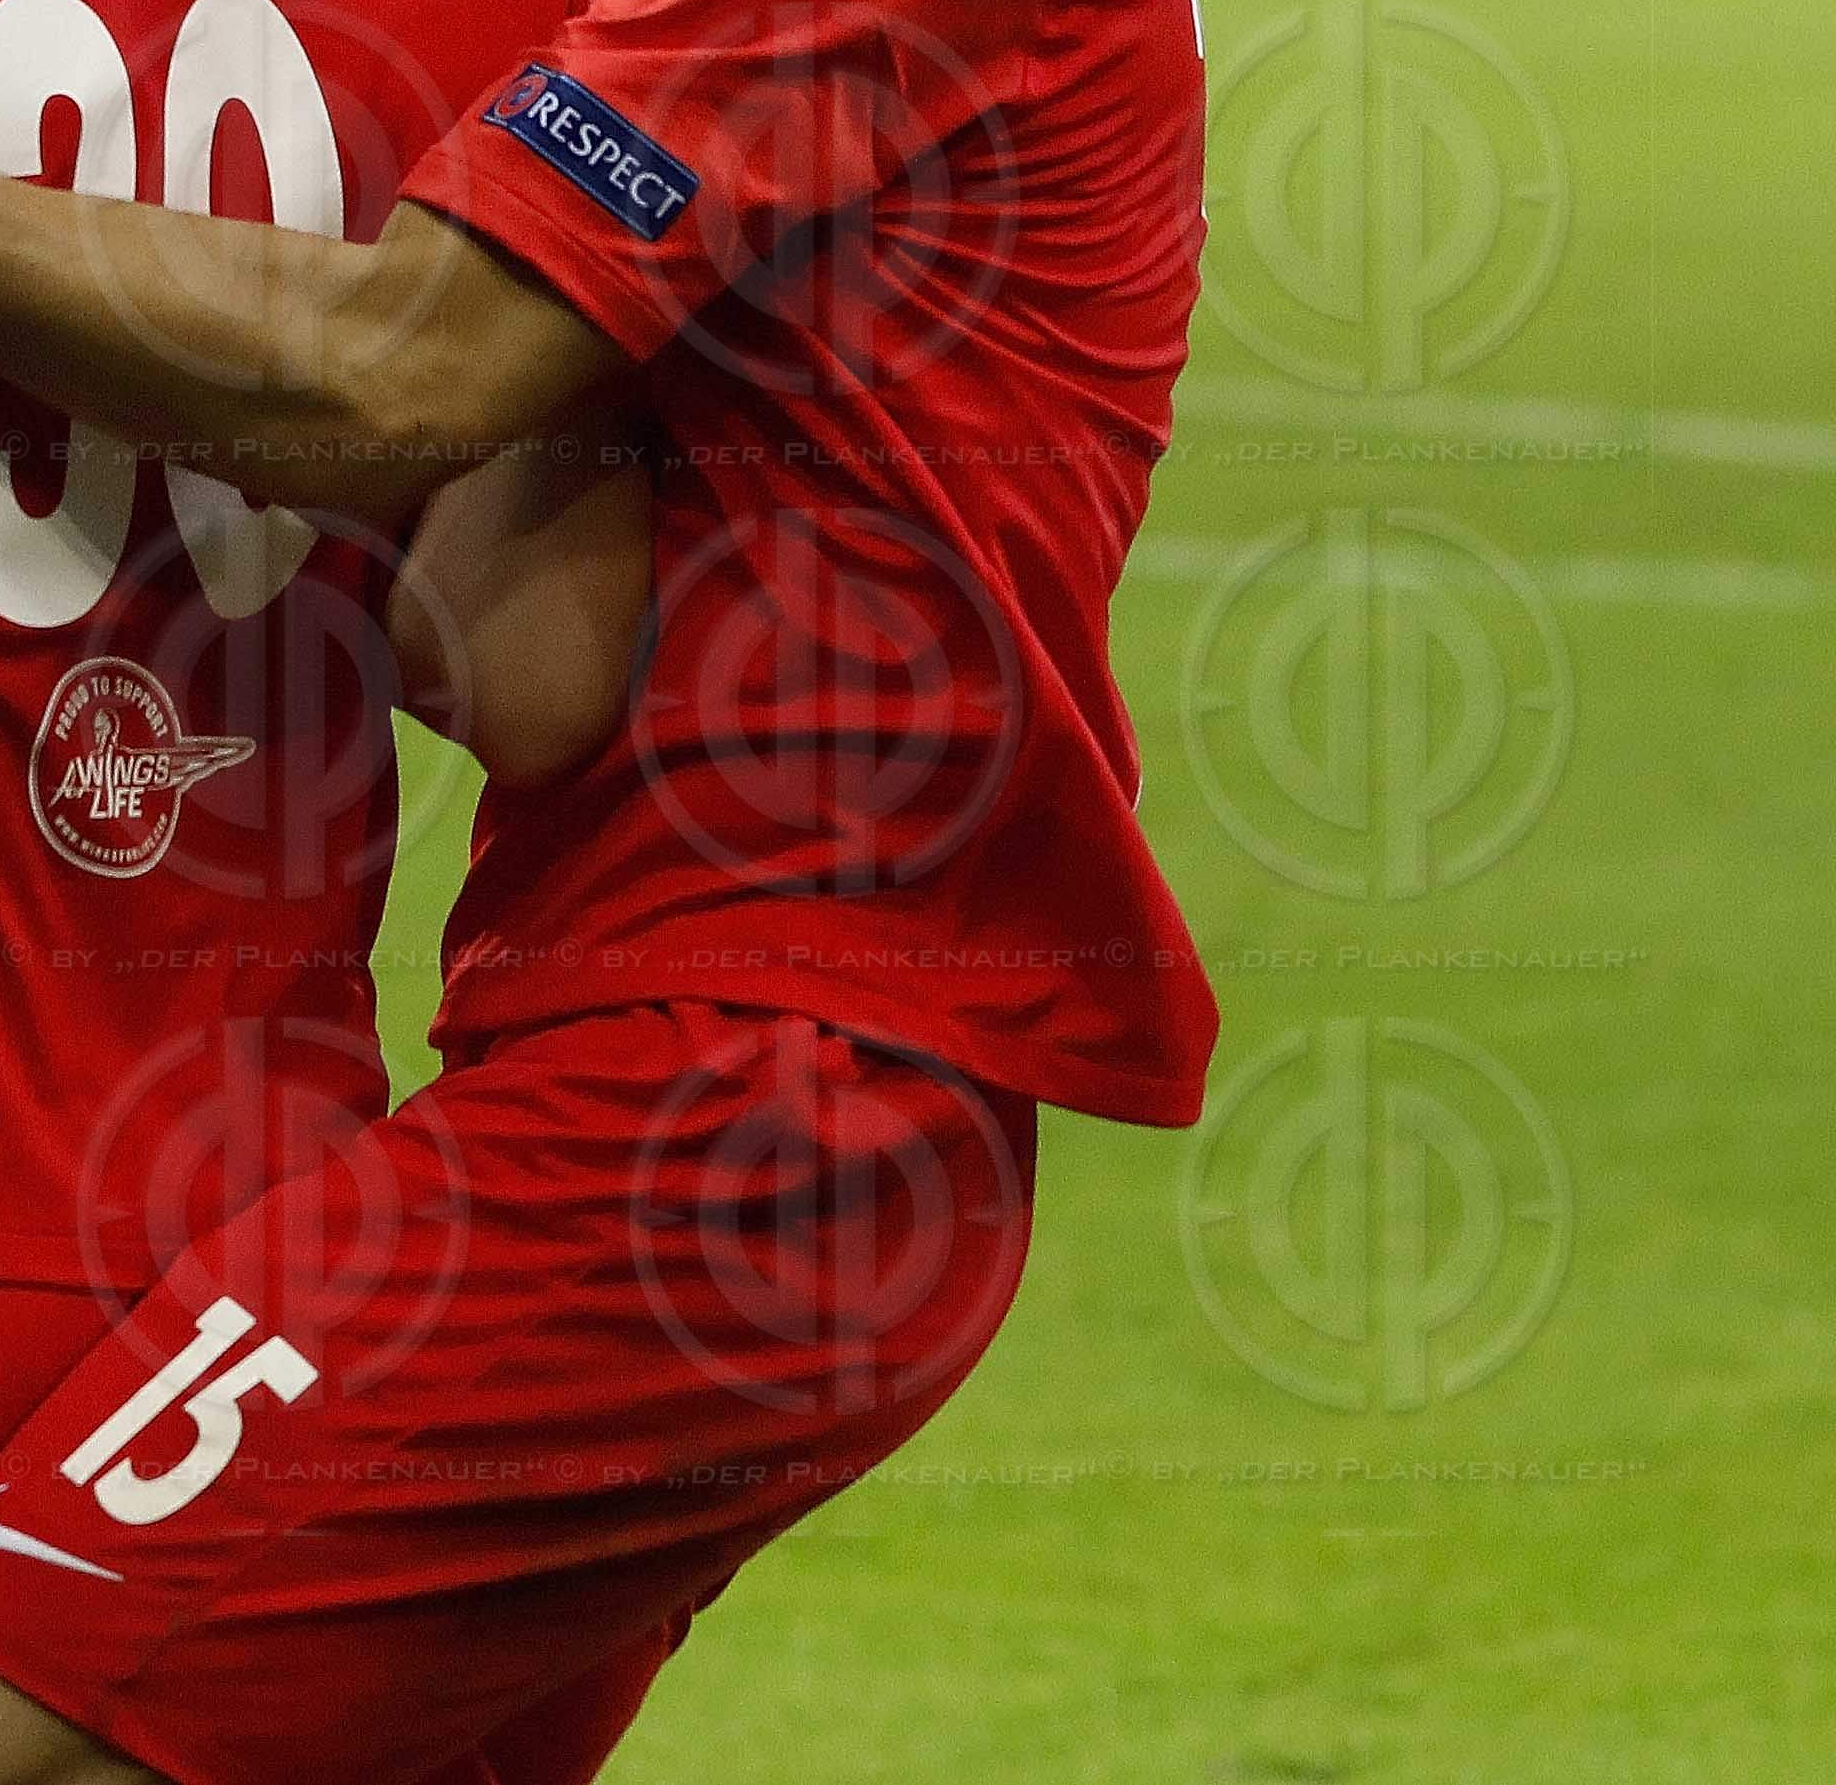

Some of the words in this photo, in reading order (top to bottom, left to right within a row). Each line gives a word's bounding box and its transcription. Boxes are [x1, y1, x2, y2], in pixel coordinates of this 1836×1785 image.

[528, 90, 686, 220] RESPECT
[55, 684, 89, 741] PROUD
[91, 675, 110, 697] TO
[115, 676, 168, 737] SUPPORT
[75, 751, 170, 787] WINGS
[89, 786, 145, 819] LIFE
[59, 1295, 320, 1525] 15
